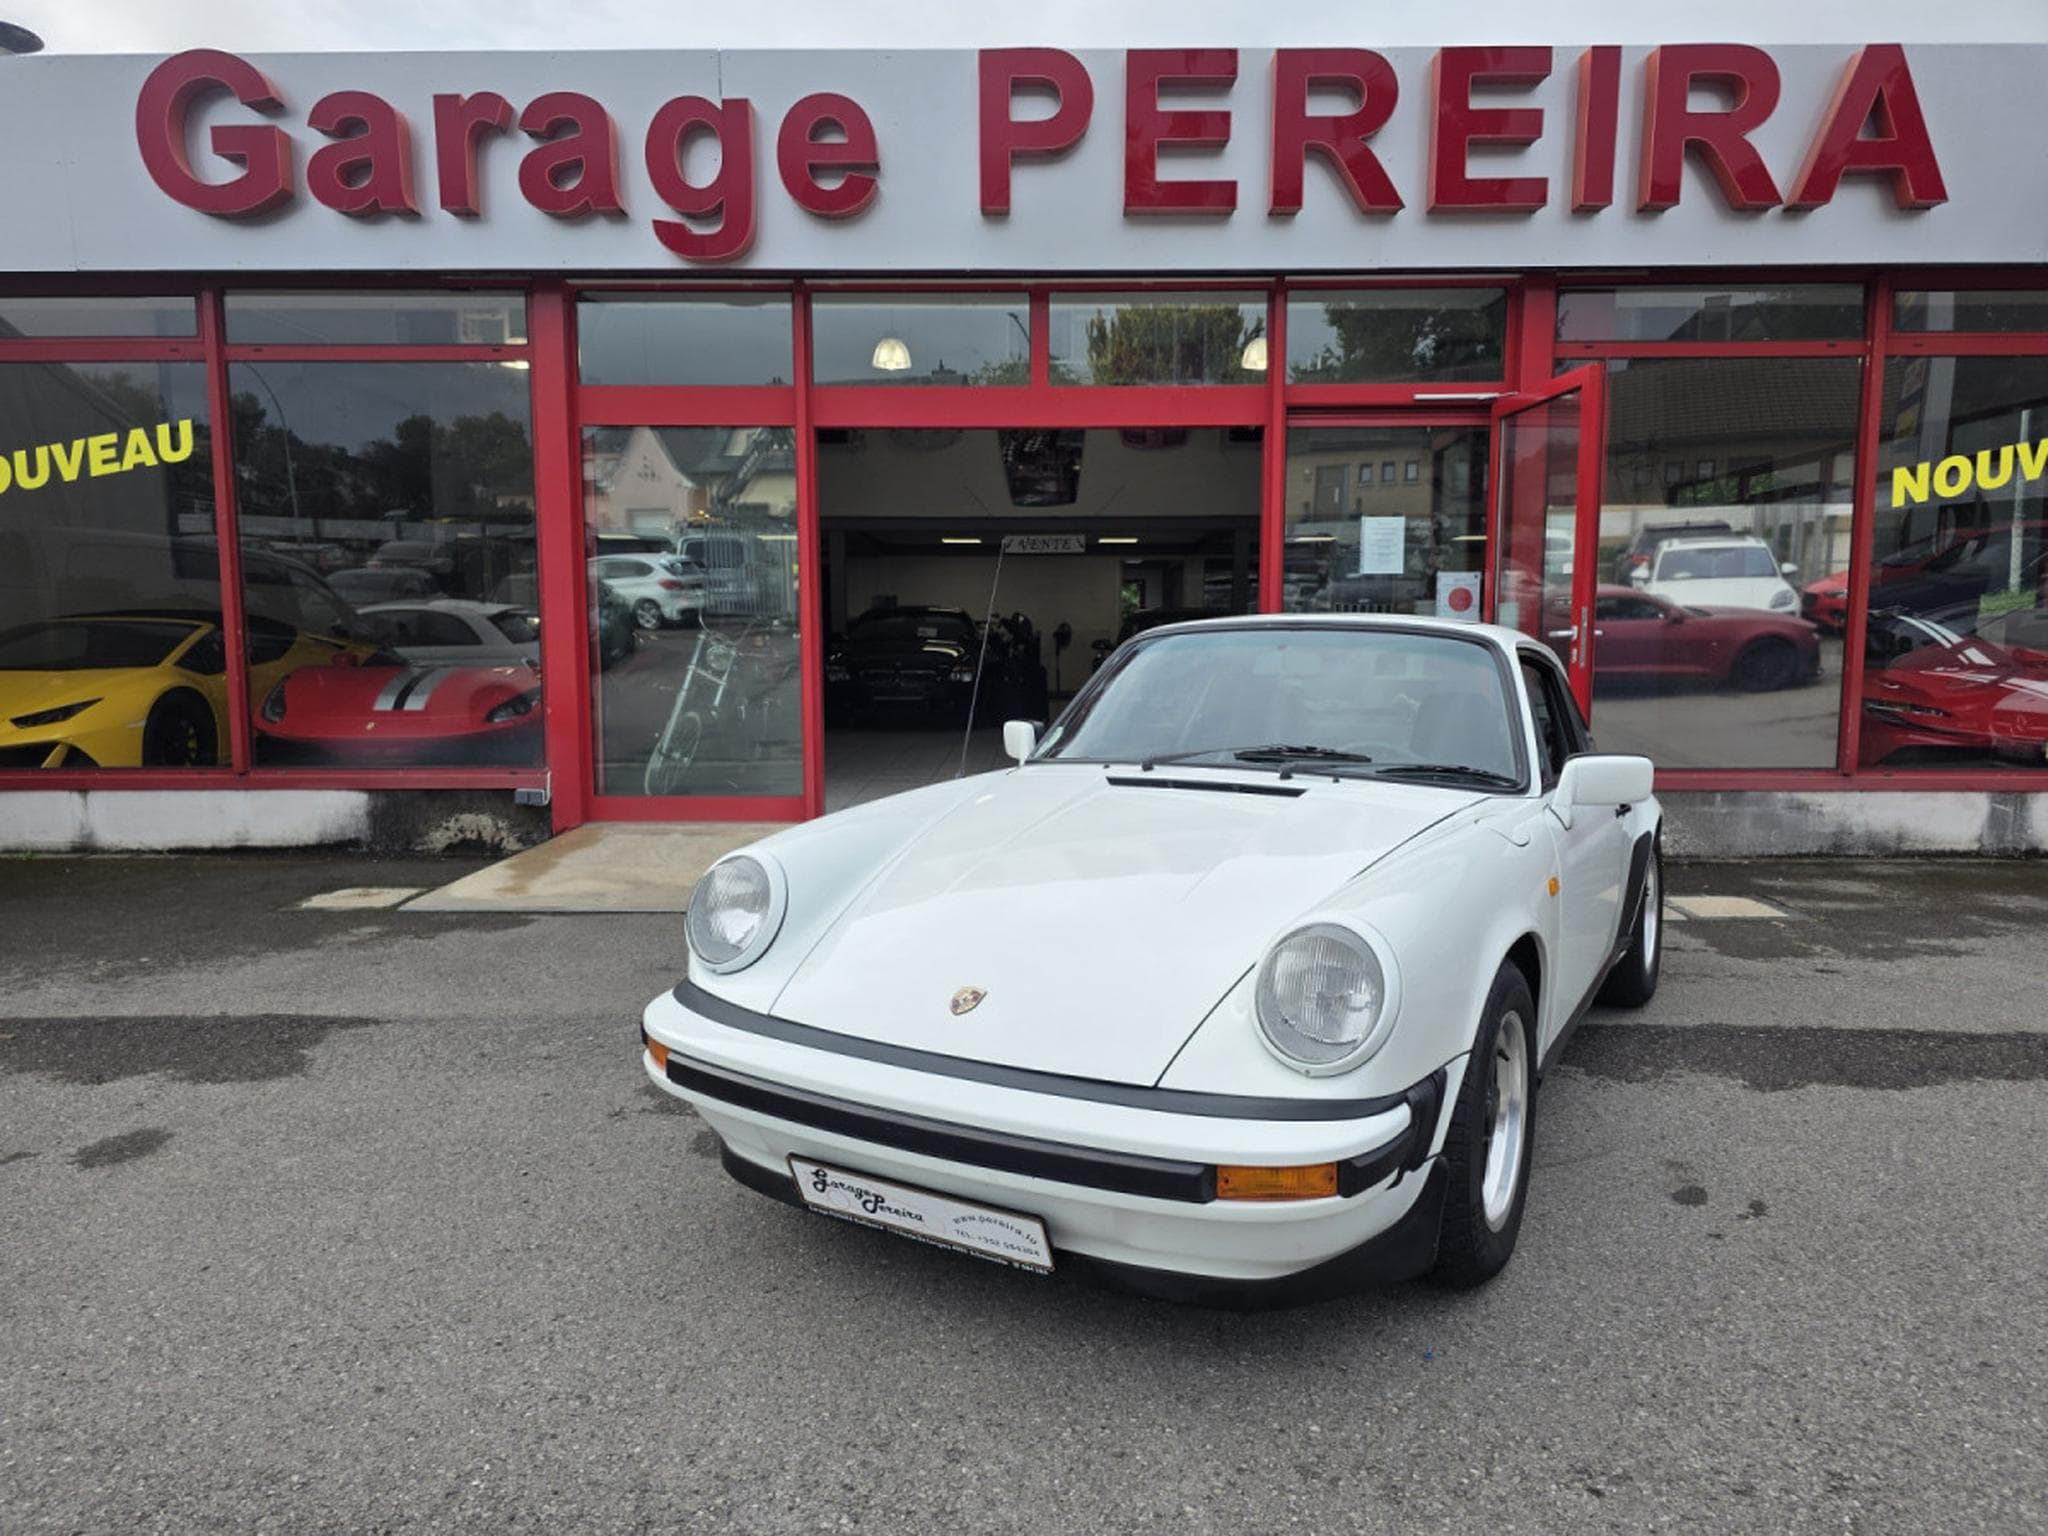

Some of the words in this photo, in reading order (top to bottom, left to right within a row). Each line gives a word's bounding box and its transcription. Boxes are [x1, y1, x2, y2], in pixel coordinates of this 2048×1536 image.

[136, 48, 881, 264] Garage
[977, 43, 1950, 216] PEREIRA
[0, 418, 195, 495] UVEAU
[811, 1168, 873, 1200] Garage
[862, 1194, 924, 1222] Pereira
